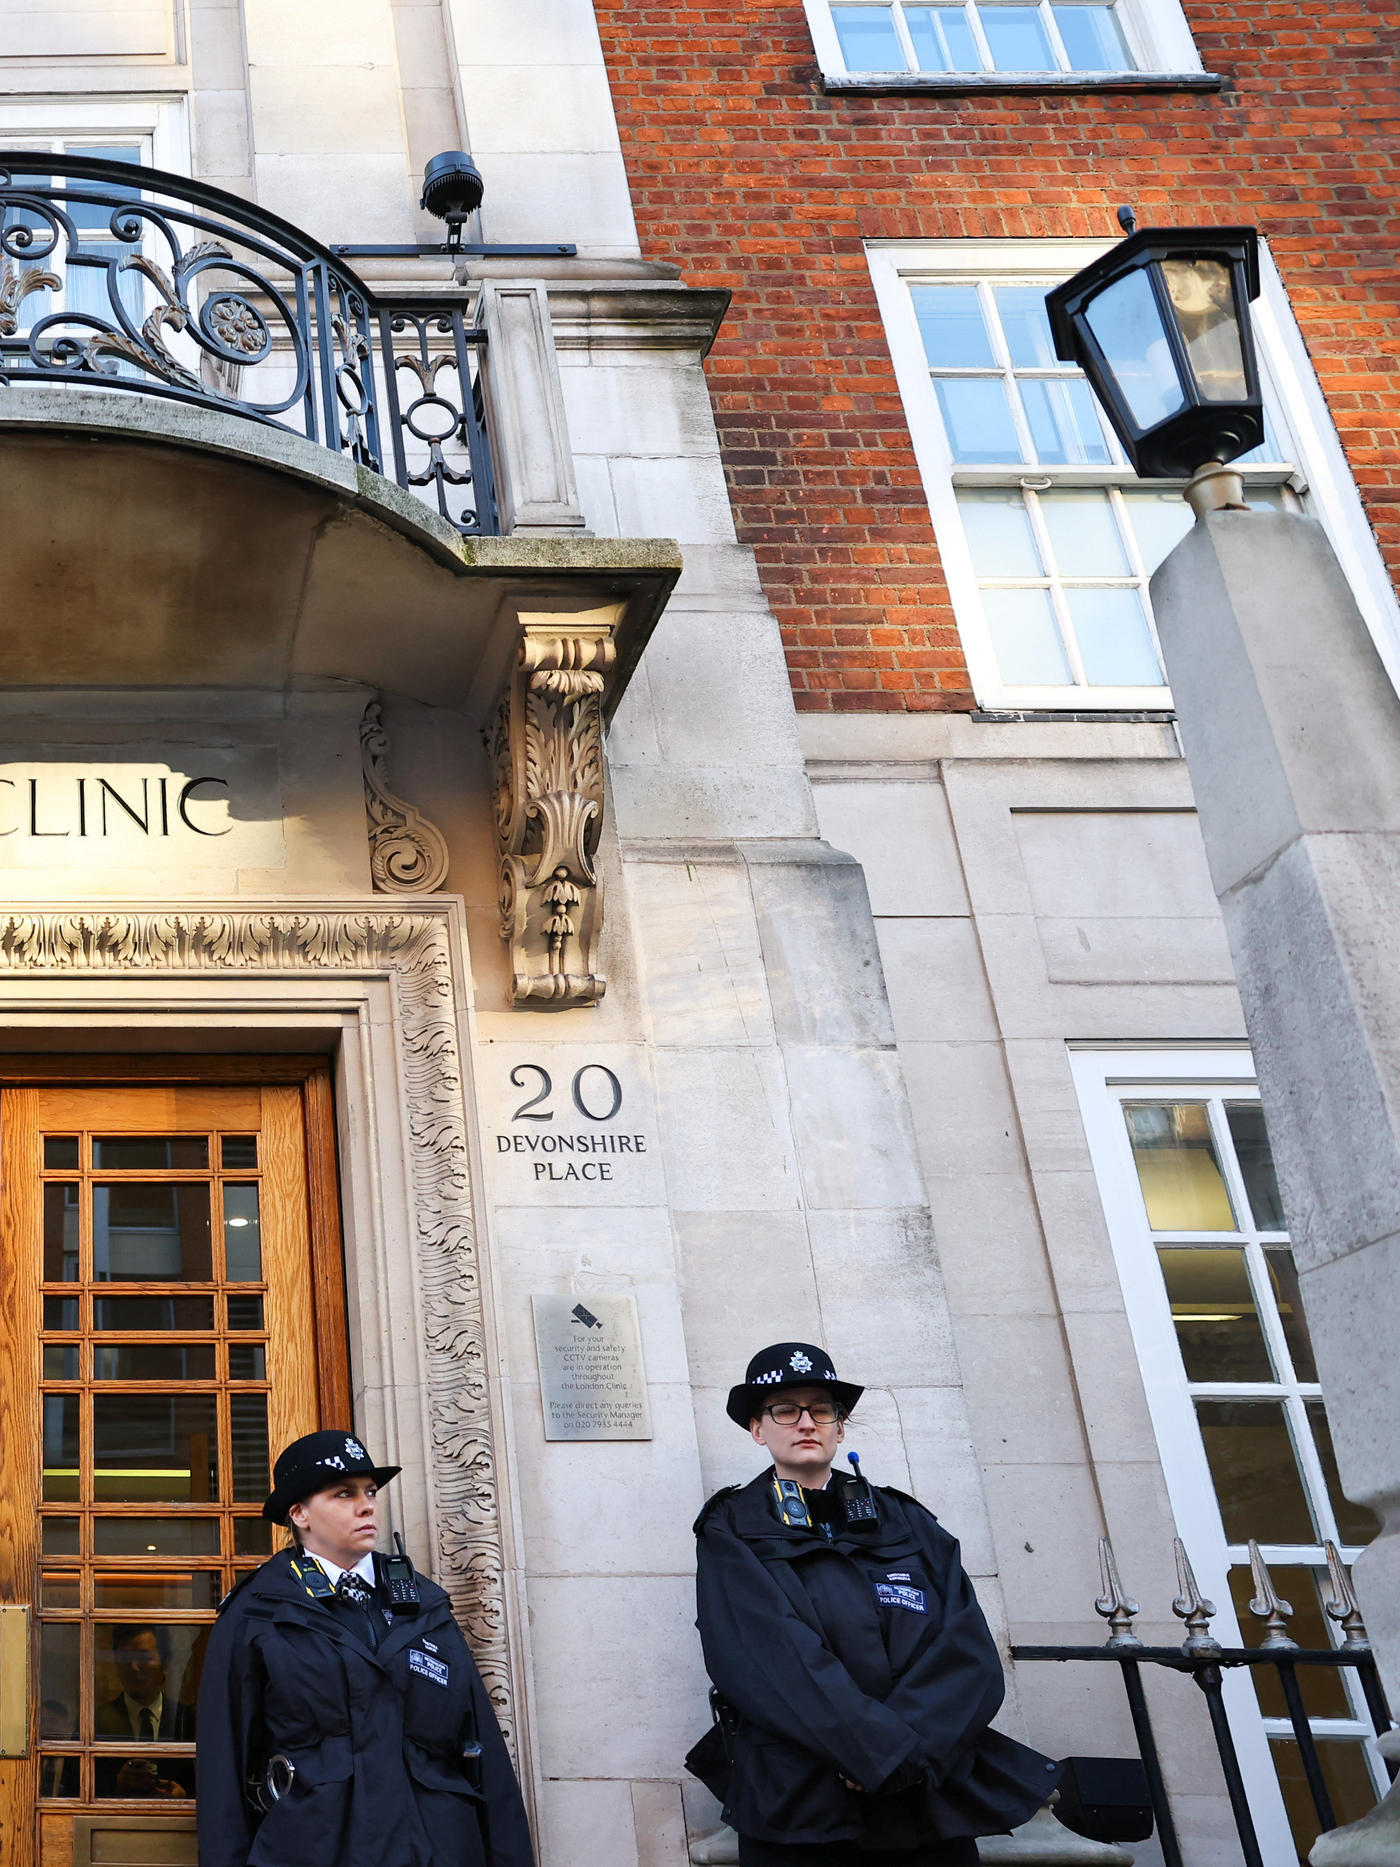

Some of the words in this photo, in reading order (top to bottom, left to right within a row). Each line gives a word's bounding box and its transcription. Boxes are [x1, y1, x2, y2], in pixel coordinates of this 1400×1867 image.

[510, 1064, 622, 1122] 20
[497, 1136, 647, 1152] DEVONSHIRE
[534, 1163, 613, 1180] PLACE
[588, 1337, 604, 1345] your
[585, 1364, 622, 1372] operation
[572, 1374, 614, 1382] throughout
[898, 1590, 916, 1600] POLICE
[902, 1599, 924, 1610] OFFICER
[427, 1662, 442, 1674] POLICE
[410, 1664, 428, 1676] POLICE
[429, 1672, 447, 1686] OFFICER
